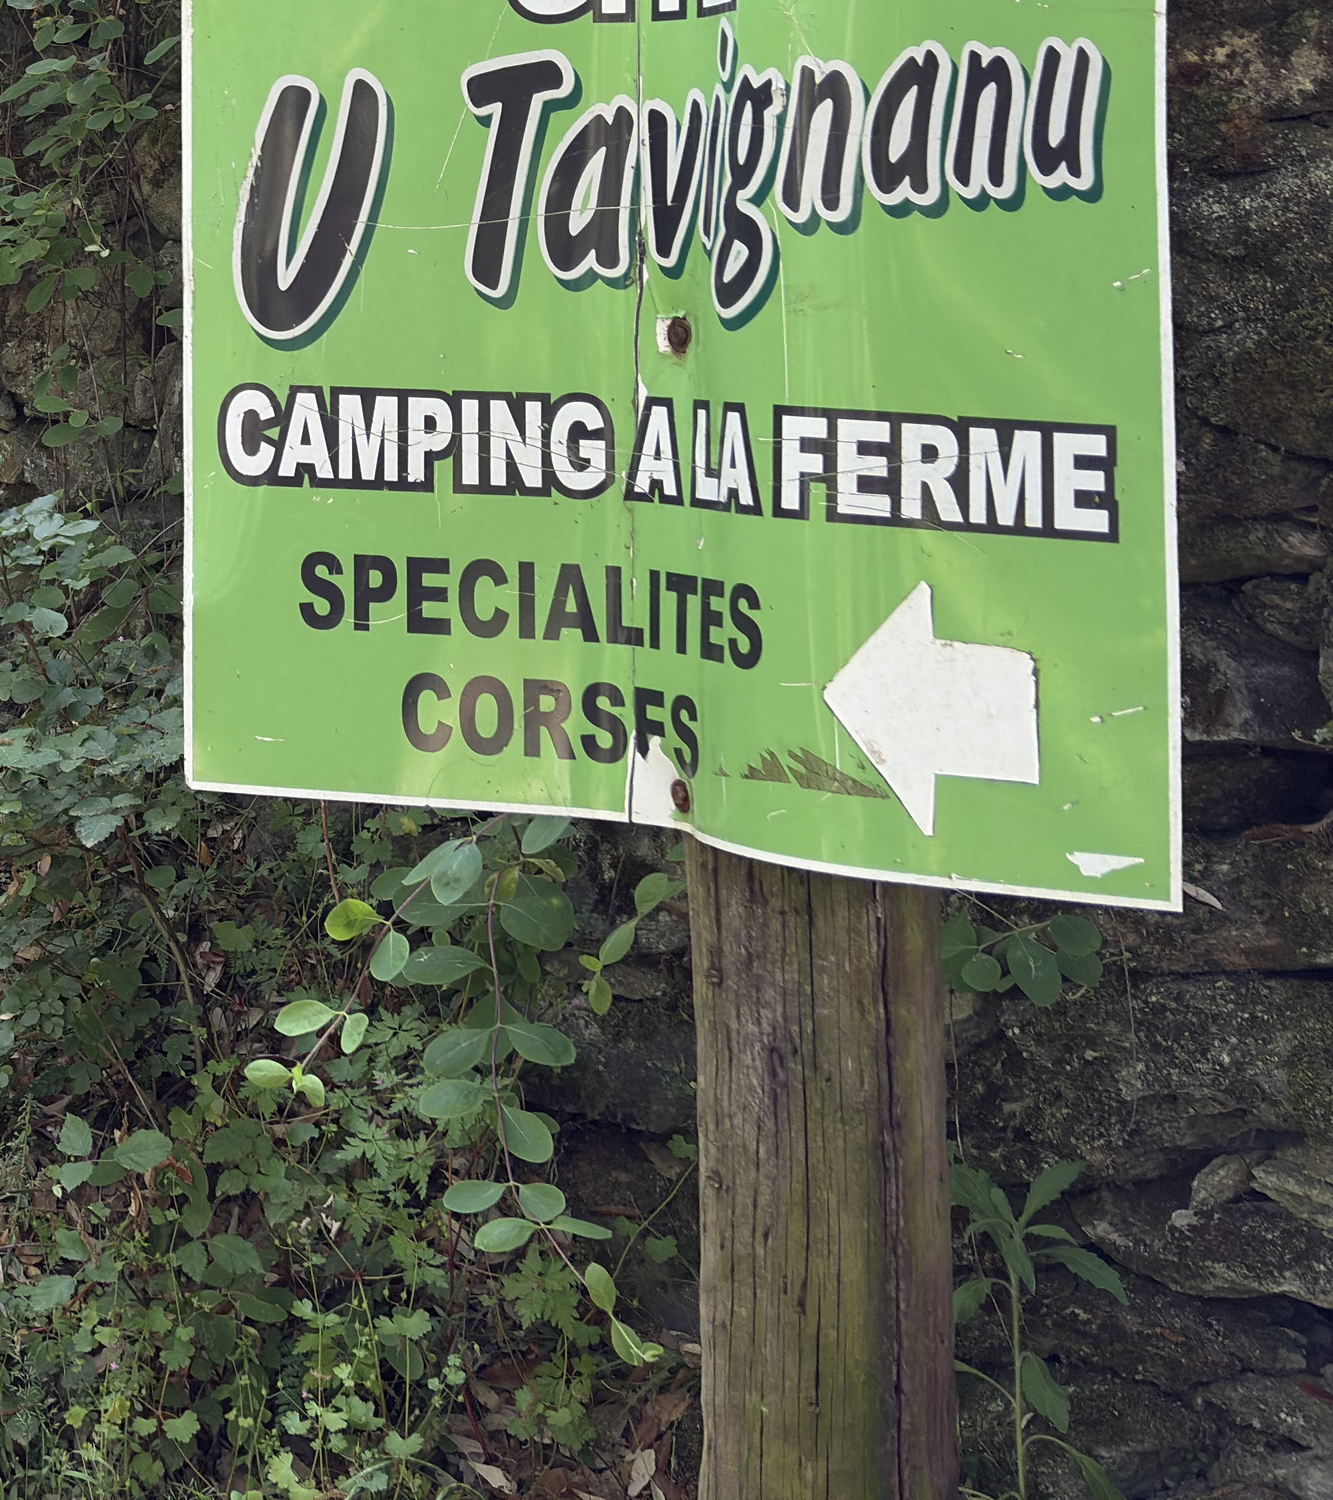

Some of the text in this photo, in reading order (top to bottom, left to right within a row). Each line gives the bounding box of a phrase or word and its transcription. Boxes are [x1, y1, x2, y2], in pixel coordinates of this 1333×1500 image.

[233, 16, 1104, 350] U Tavignanu
[220, 383, 1119, 540] CAMPING A LA FERME
[299, 551, 764, 671] SPECIALITES
